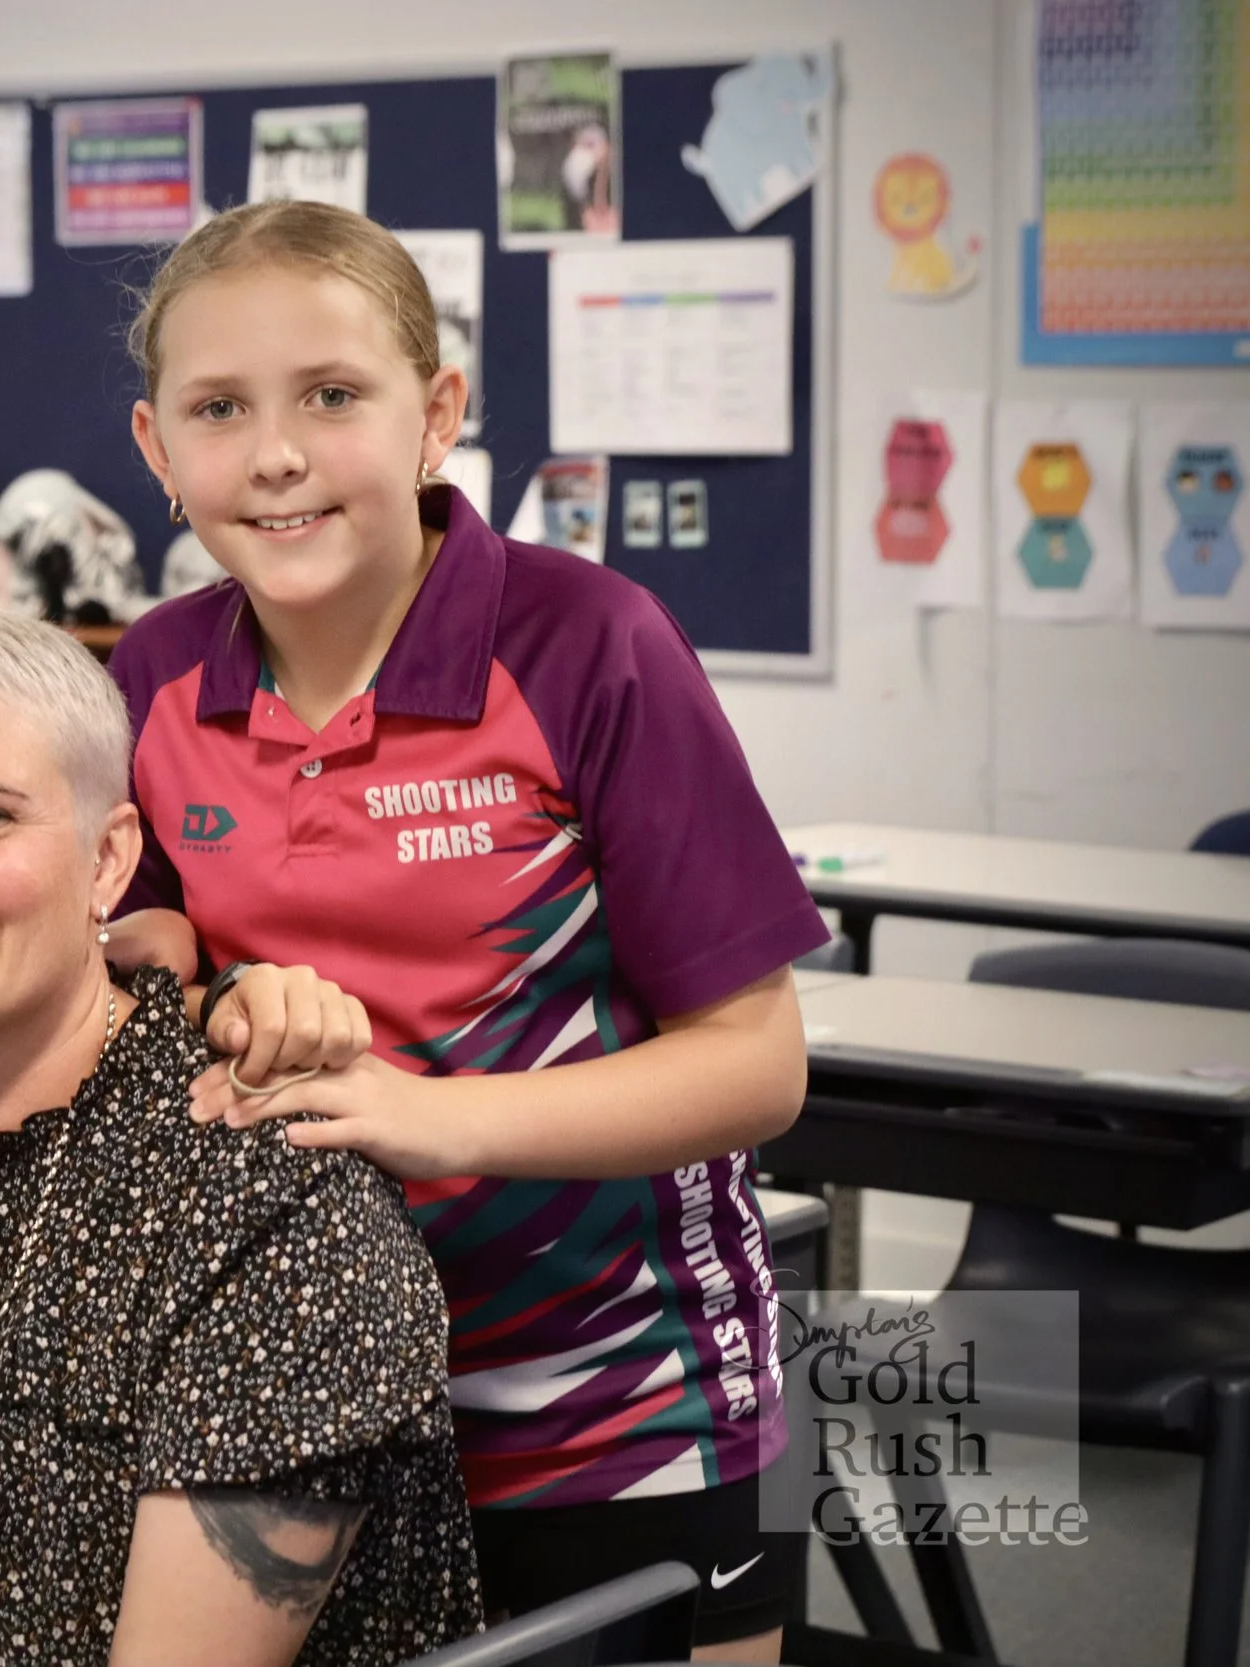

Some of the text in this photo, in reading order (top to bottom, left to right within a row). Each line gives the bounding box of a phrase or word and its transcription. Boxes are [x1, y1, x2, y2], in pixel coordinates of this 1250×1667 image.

[364, 772, 518, 819] SHOOTING
[397, 821, 494, 864] STARS
[674, 1160, 757, 1422] SHOOTING STARS
